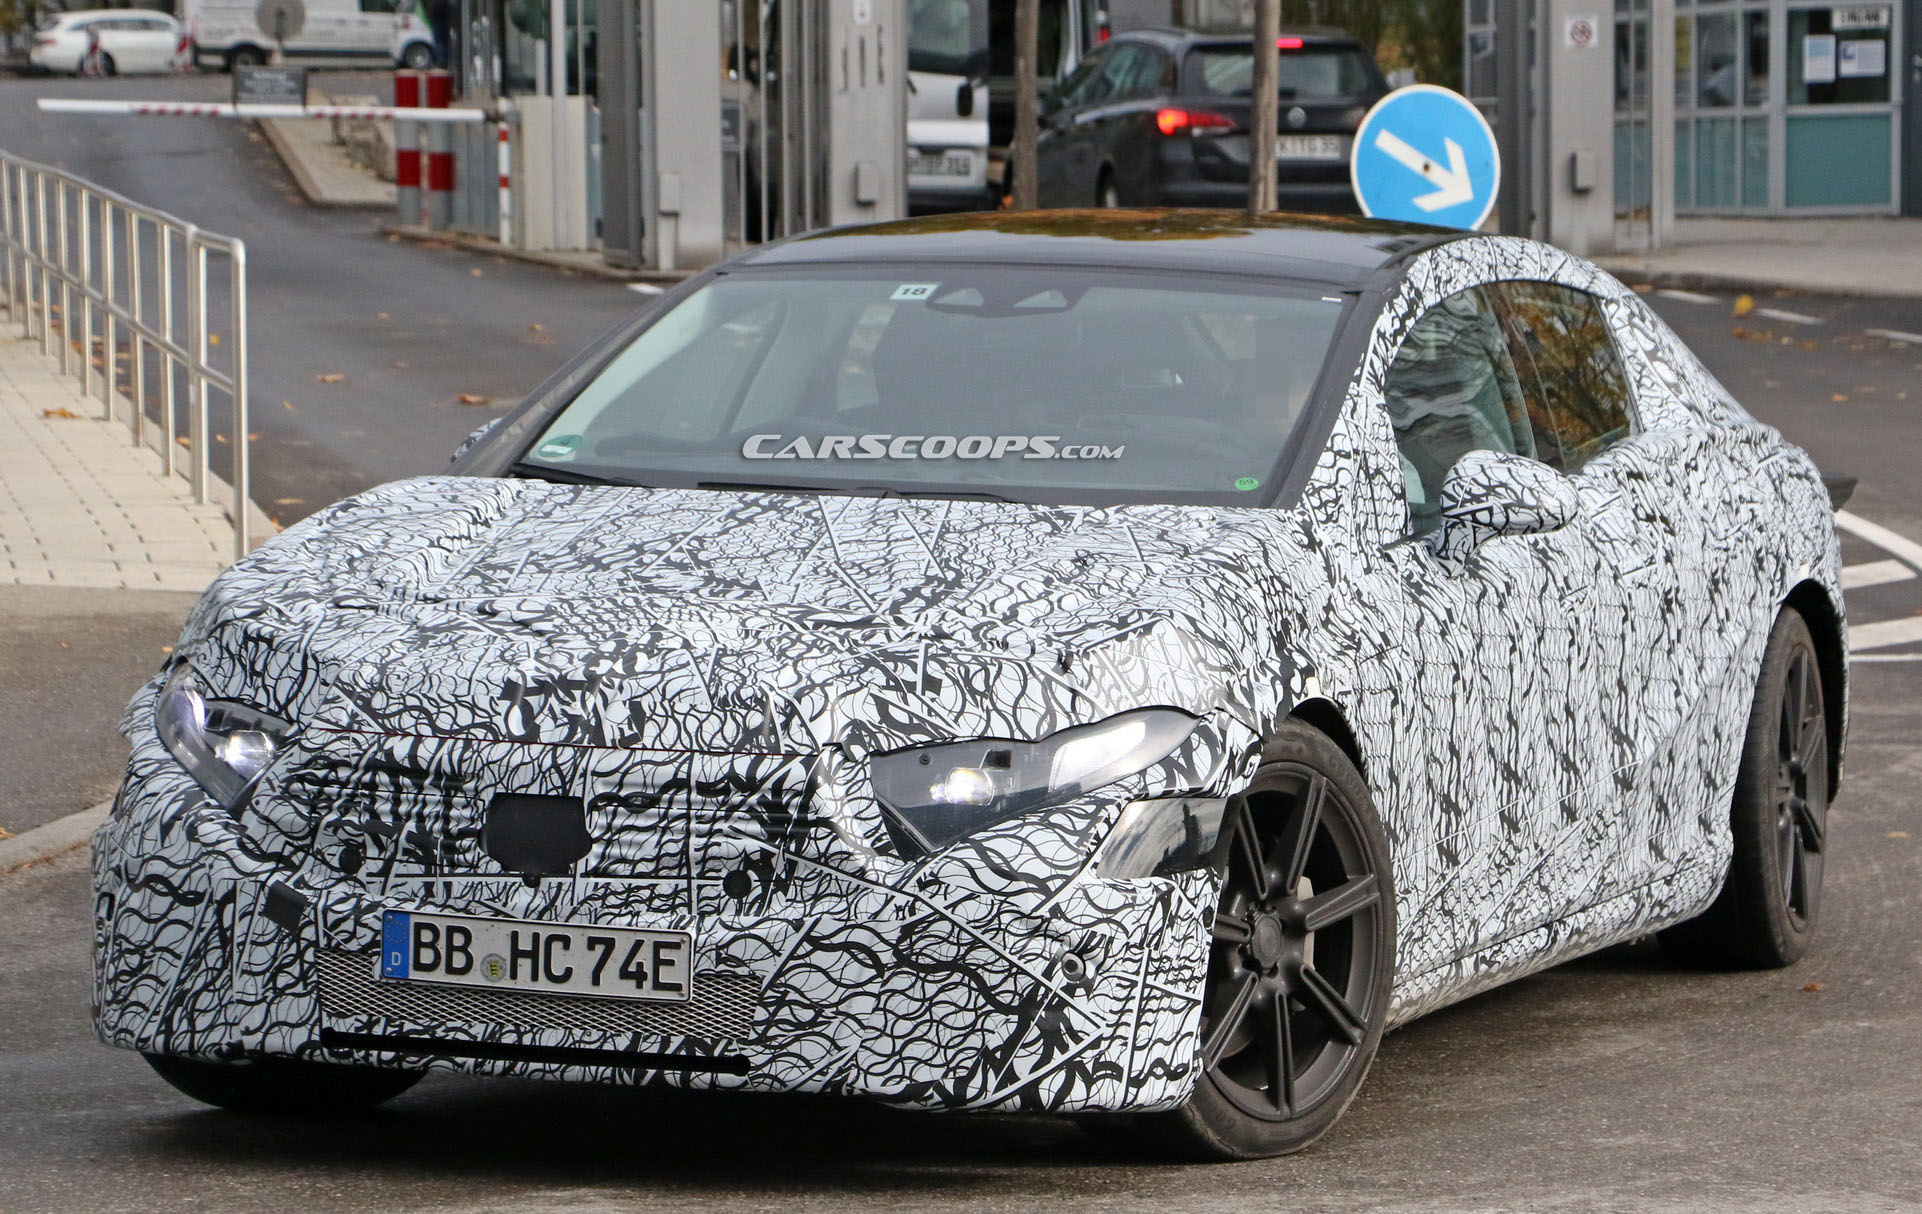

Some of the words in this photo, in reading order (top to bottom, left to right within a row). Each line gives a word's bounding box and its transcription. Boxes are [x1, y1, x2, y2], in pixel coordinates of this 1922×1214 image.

[901, 287, 928, 296] 18
[391, 951, 401, 966] D
[413, 922, 474, 975] BB
[509, 930, 574, 984] HC
[588, 937, 683, 991] 74E
